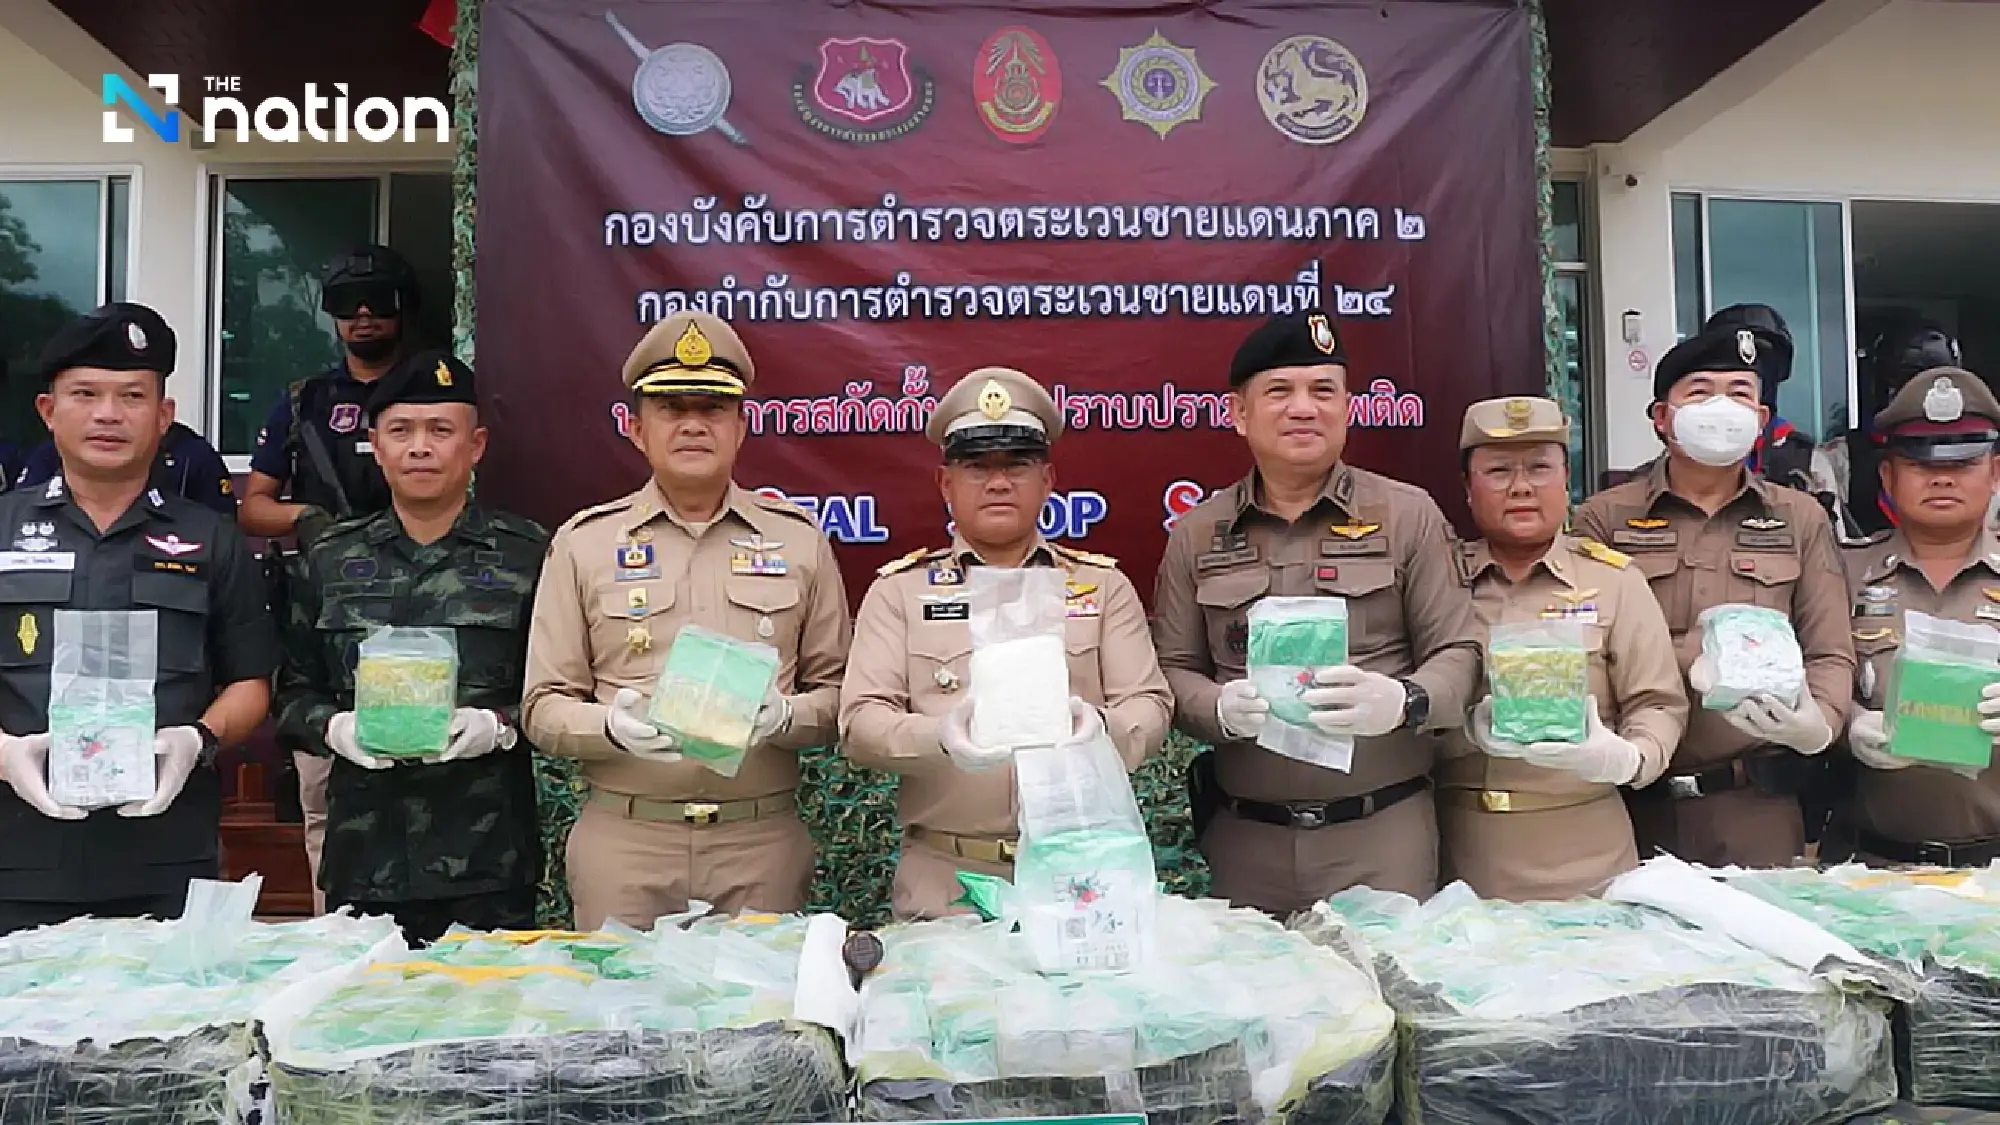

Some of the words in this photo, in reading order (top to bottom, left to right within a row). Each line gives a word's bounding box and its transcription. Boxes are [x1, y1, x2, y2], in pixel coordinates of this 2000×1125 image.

[604, 192, 1379, 246] กองบังคับการตำรวจตระเวนชายแดนภาค
[1394, 208, 1426, 240] ๒
[1333, 284, 1396, 316] ๒๔
